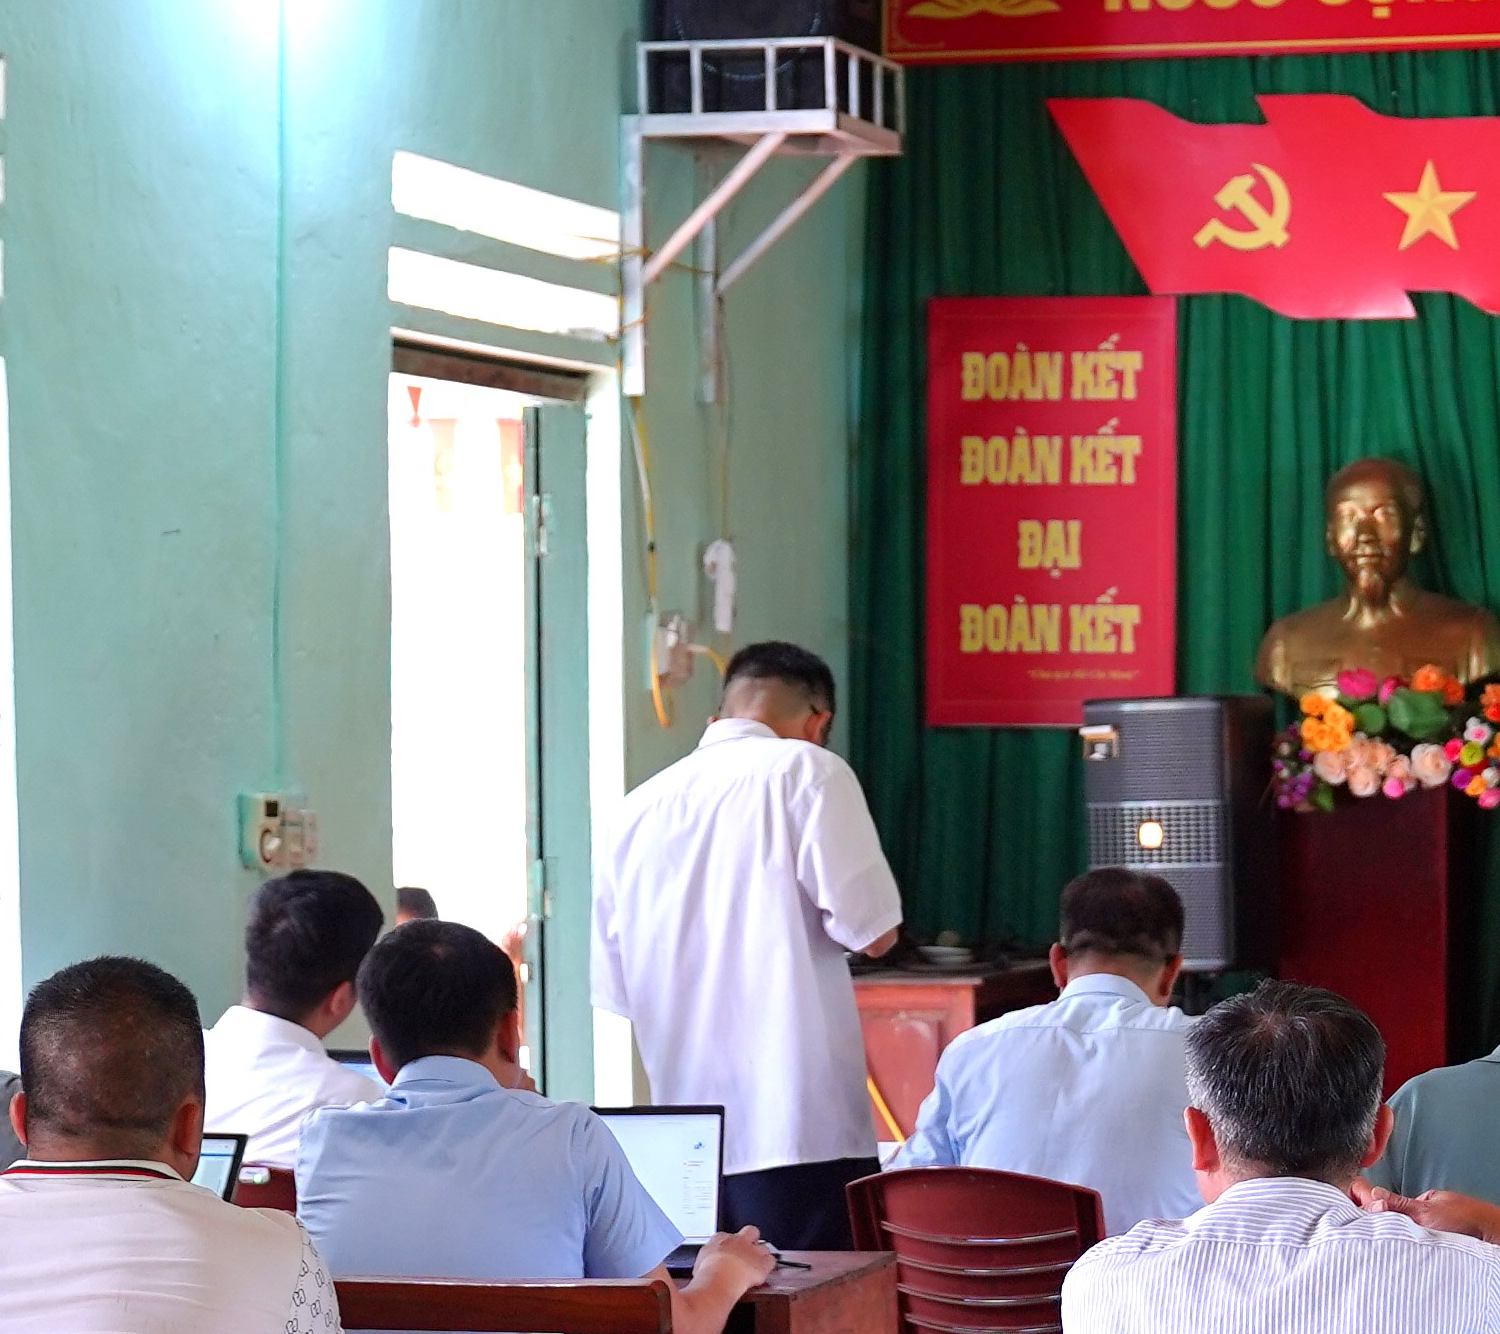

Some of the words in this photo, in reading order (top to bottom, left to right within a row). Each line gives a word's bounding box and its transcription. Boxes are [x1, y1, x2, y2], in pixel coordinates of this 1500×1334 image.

[961, 342, 1063, 401] ĐOÀN
[1069, 333, 1143, 401] KẾT
[961, 425, 1062, 485] ĐOÀN
[1069, 417, 1142, 485] KẾT
[1017, 519, 1082, 580] ĐẠI
[960, 593, 1061, 653] ĐOÀN
[1068, 585, 1141, 653] KẾT
